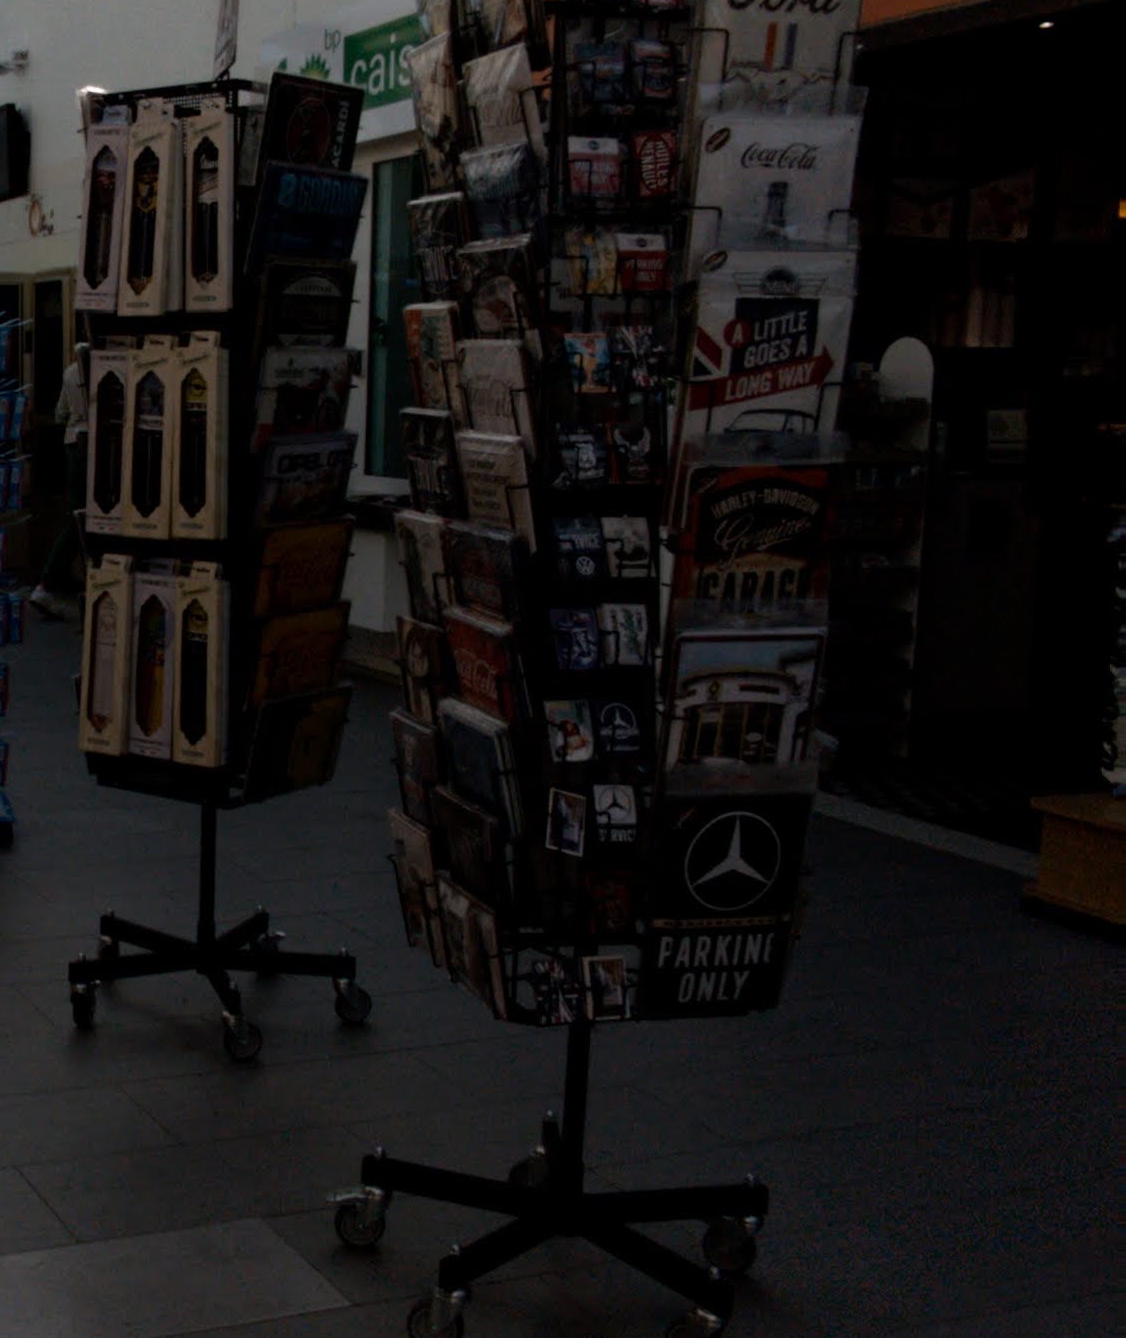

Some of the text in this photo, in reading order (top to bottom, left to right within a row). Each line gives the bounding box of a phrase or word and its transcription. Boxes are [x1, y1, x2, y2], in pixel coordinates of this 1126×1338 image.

[324, 29, 341, 53] bp
[732, 310, 809, 343] A LITTLE
[743, 337, 808, 369] GOES A
[724, 363, 814, 401] LONG WAY
[677, 970, 751, 1004] ONLY
